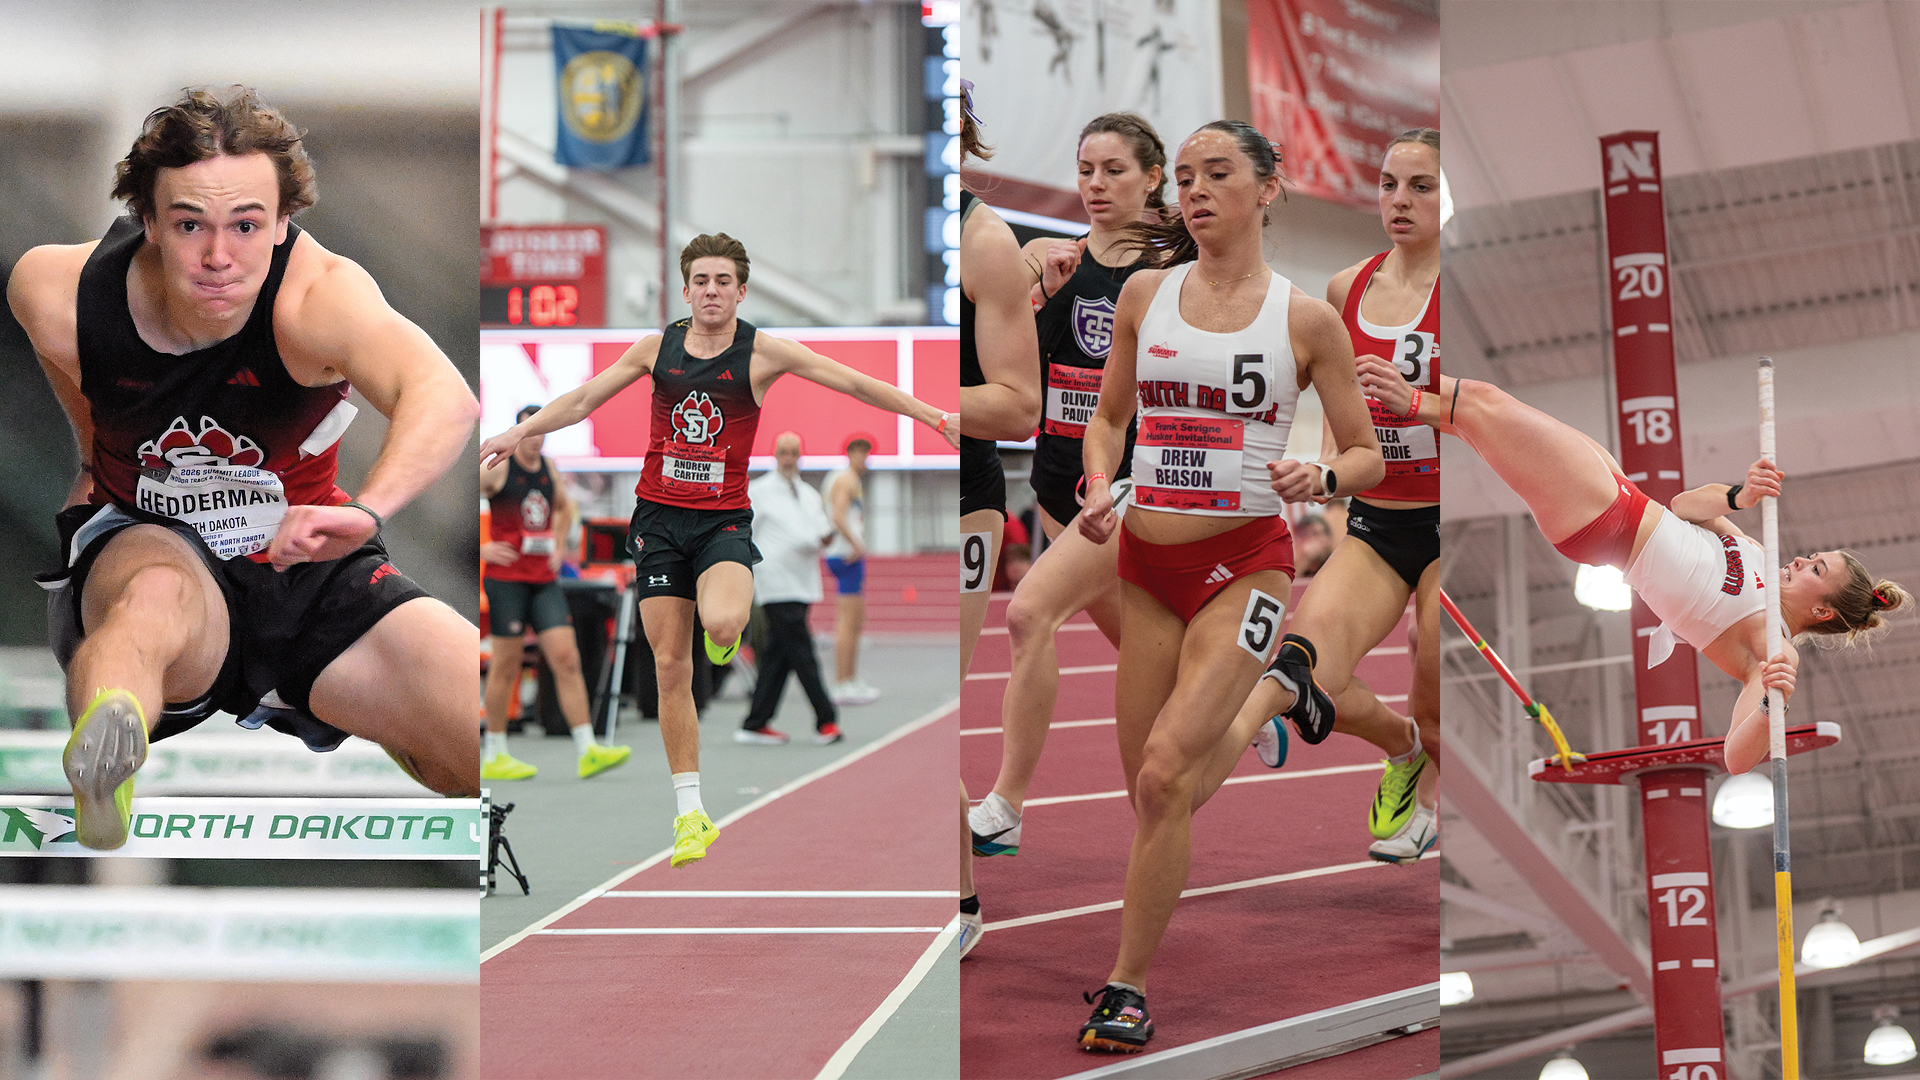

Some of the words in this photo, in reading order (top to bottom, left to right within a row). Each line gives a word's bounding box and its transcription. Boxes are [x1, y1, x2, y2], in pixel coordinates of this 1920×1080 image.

[1608, 141, 1655, 182] N
[1619, 265, 1664, 300] 20
[1401, 334, 1424, 382] 3
[1054, 369, 1075, 378] Frank
[1079, 372, 1103, 381] Sevig
[1231, 354, 1266, 409] 5
[1061, 391, 1098, 408] OLIVIA
[1156, 423, 1177, 431] Frank
[1180, 423, 1221, 434] Sevigne
[1175, 433, 1232, 444] Invitational
[1628, 410, 1673, 444] 18
[674, 459, 711, 471] ANDREW
[1161, 449, 1206, 467] DREW
[203, 468, 232, 477] SUMMIT
[234, 469, 260, 478] LEAGUE
[674, 469, 710, 481] CARTIER
[1155, 468, 1213, 488] BEASON
[140, 489, 280, 517] HEDDERMAN
[1113, 484, 1132, 509] 7
[209, 516, 248, 532] DAKOTA
[220, 537, 241, 547] NORTH
[242, 533, 266, 543] DAKOTA
[964, 535, 985, 589] 9
[1721, 550, 1745, 596] DAKOTA
[1245, 596, 1280, 653] 5
[1648, 721, 1691, 746] 14
[129, 814, 254, 839] ORTH
[269, 814, 454, 840] DAKOTA
[1658, 887, 1708, 927] 12
